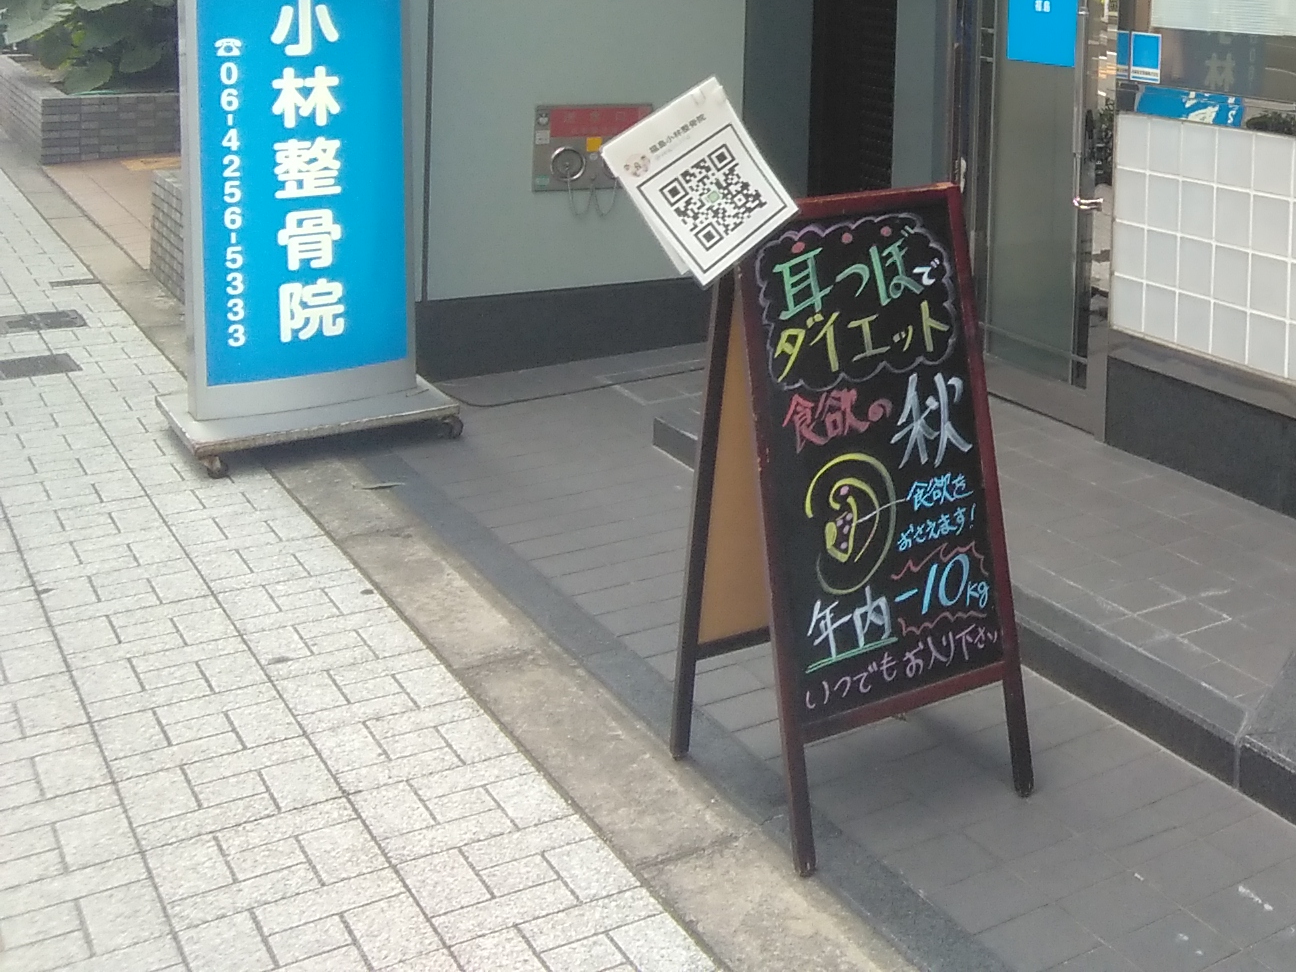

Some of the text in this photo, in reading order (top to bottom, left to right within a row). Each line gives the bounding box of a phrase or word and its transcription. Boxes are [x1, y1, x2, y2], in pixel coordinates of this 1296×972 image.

[219, 61, 246, 348] 06-4256-5333
[772, 225, 941, 321] 耳つぼで
[774, 299, 950, 383] ダイエット
[906, 472, 974, 511] 食欲を
